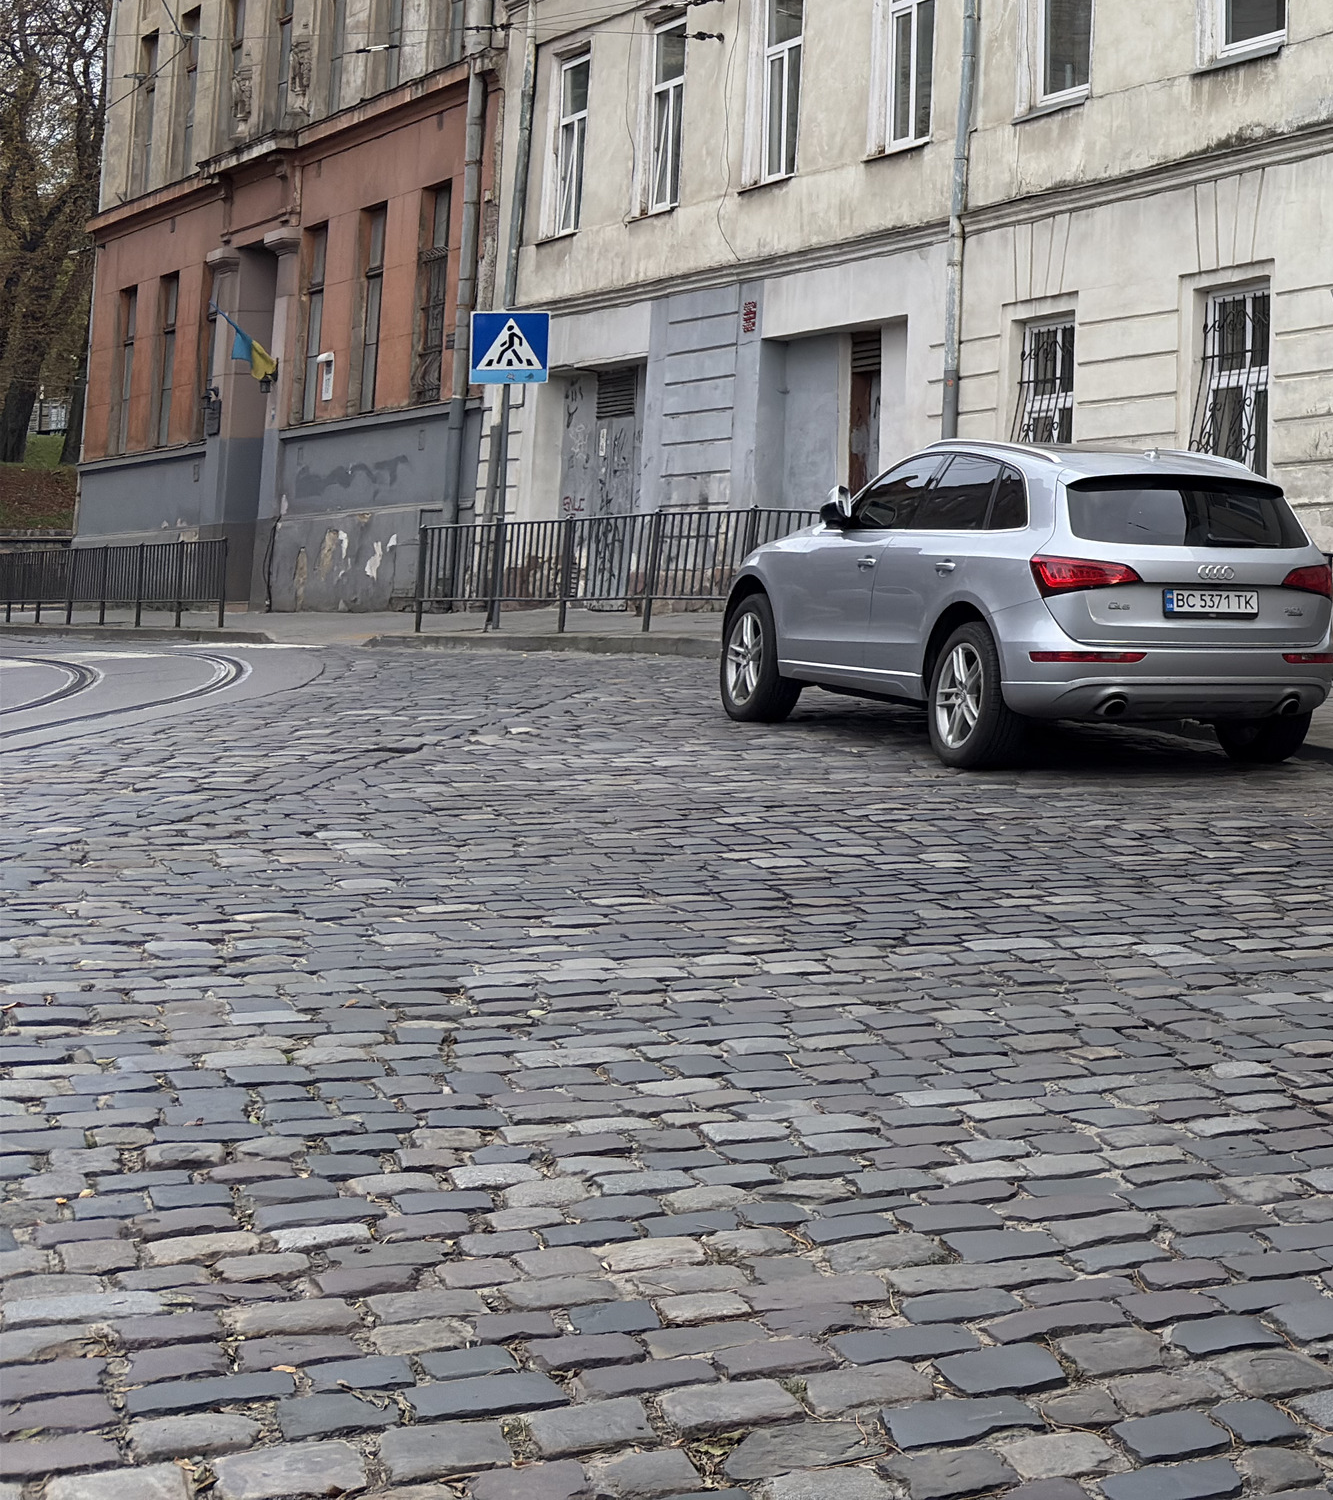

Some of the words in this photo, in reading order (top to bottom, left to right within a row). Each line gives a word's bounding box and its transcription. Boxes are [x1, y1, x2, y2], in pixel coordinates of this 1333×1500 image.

[1176, 593, 1197, 609] BC
[1200, 594, 1231, 609] 5371
[1234, 594, 1255, 610] TK
